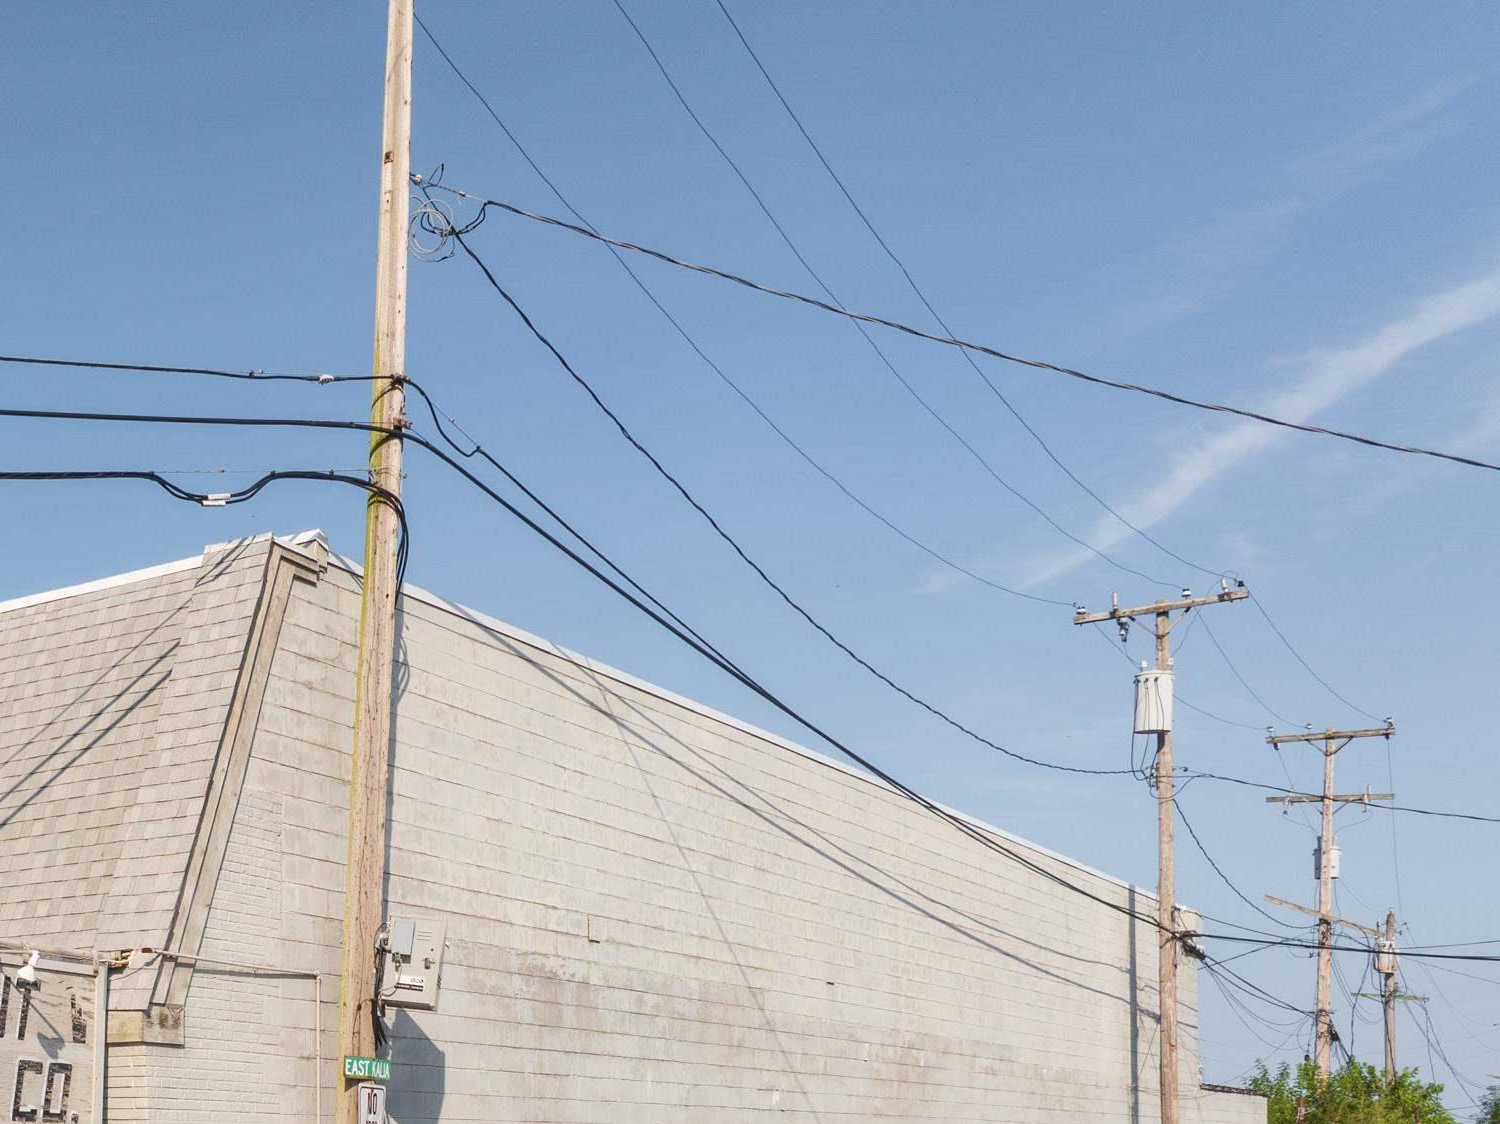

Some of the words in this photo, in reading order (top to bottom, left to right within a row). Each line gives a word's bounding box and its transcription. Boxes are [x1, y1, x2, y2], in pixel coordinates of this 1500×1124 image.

[345, 1058, 370, 1077] EAST
[11, 1058, 79, 1124] CO.
[367, 1092, 378, 1116] NO
